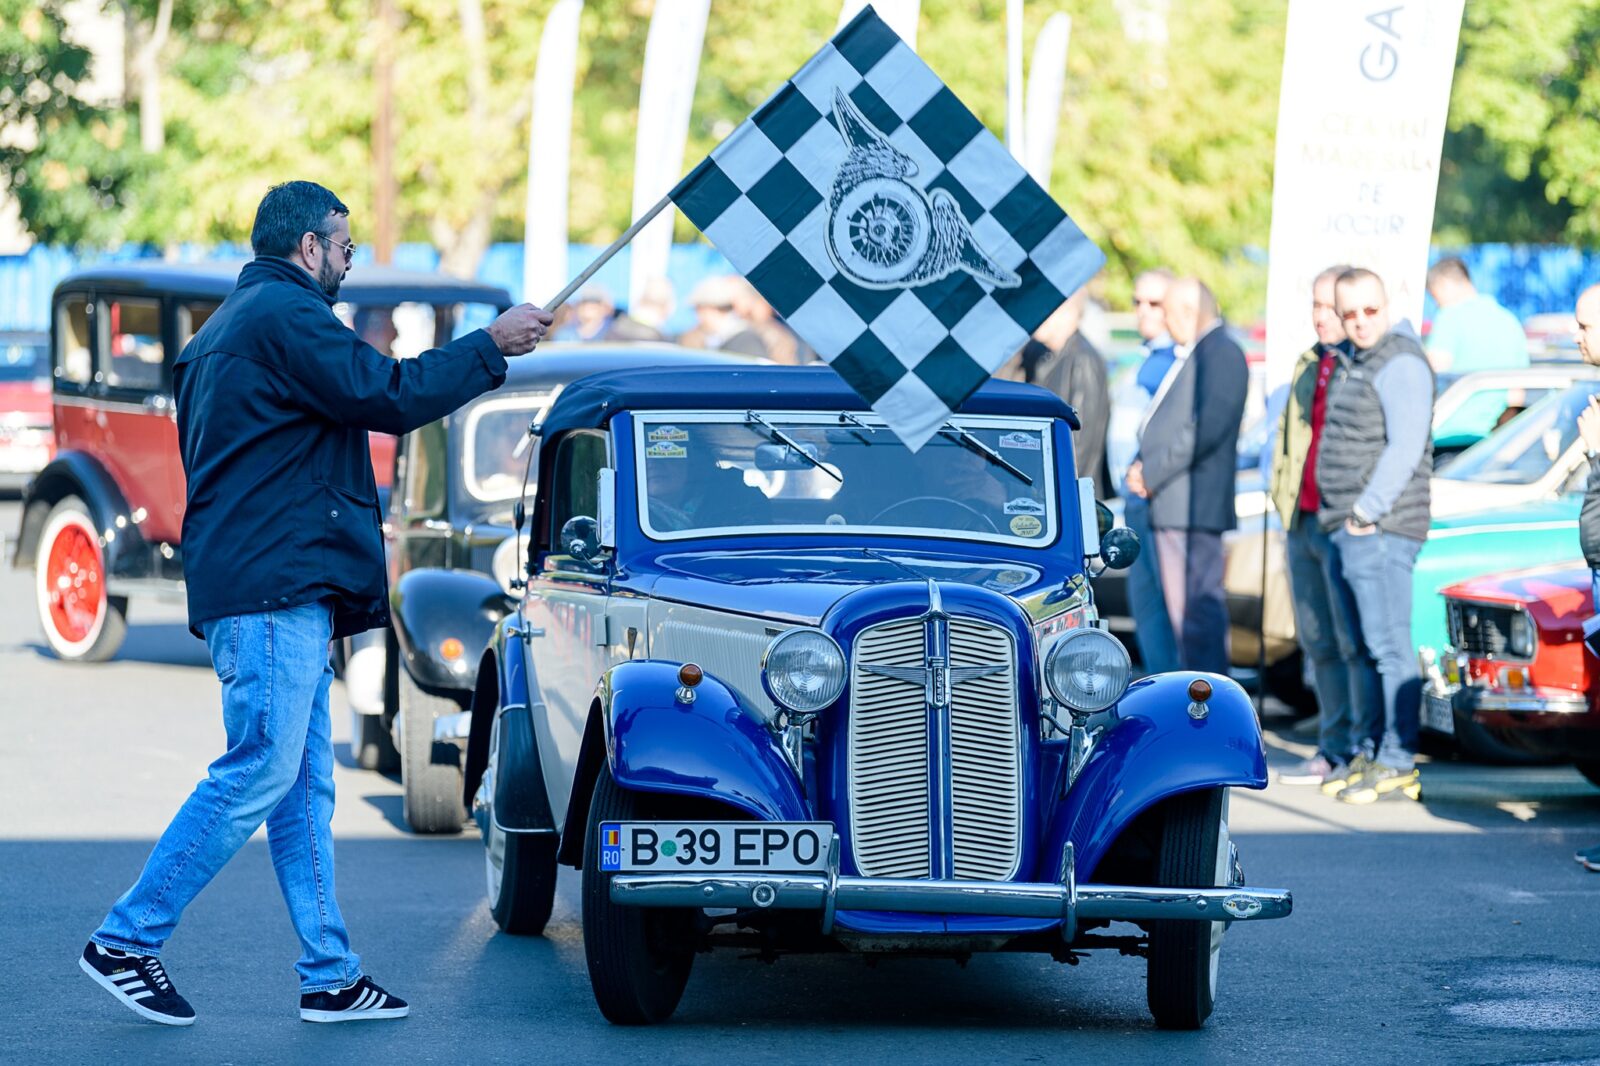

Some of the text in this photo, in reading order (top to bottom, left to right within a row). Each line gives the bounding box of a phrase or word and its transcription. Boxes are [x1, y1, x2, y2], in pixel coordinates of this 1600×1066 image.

[603, 850, 620, 866] RO
[631, 828, 820, 866] B 39 EPO
